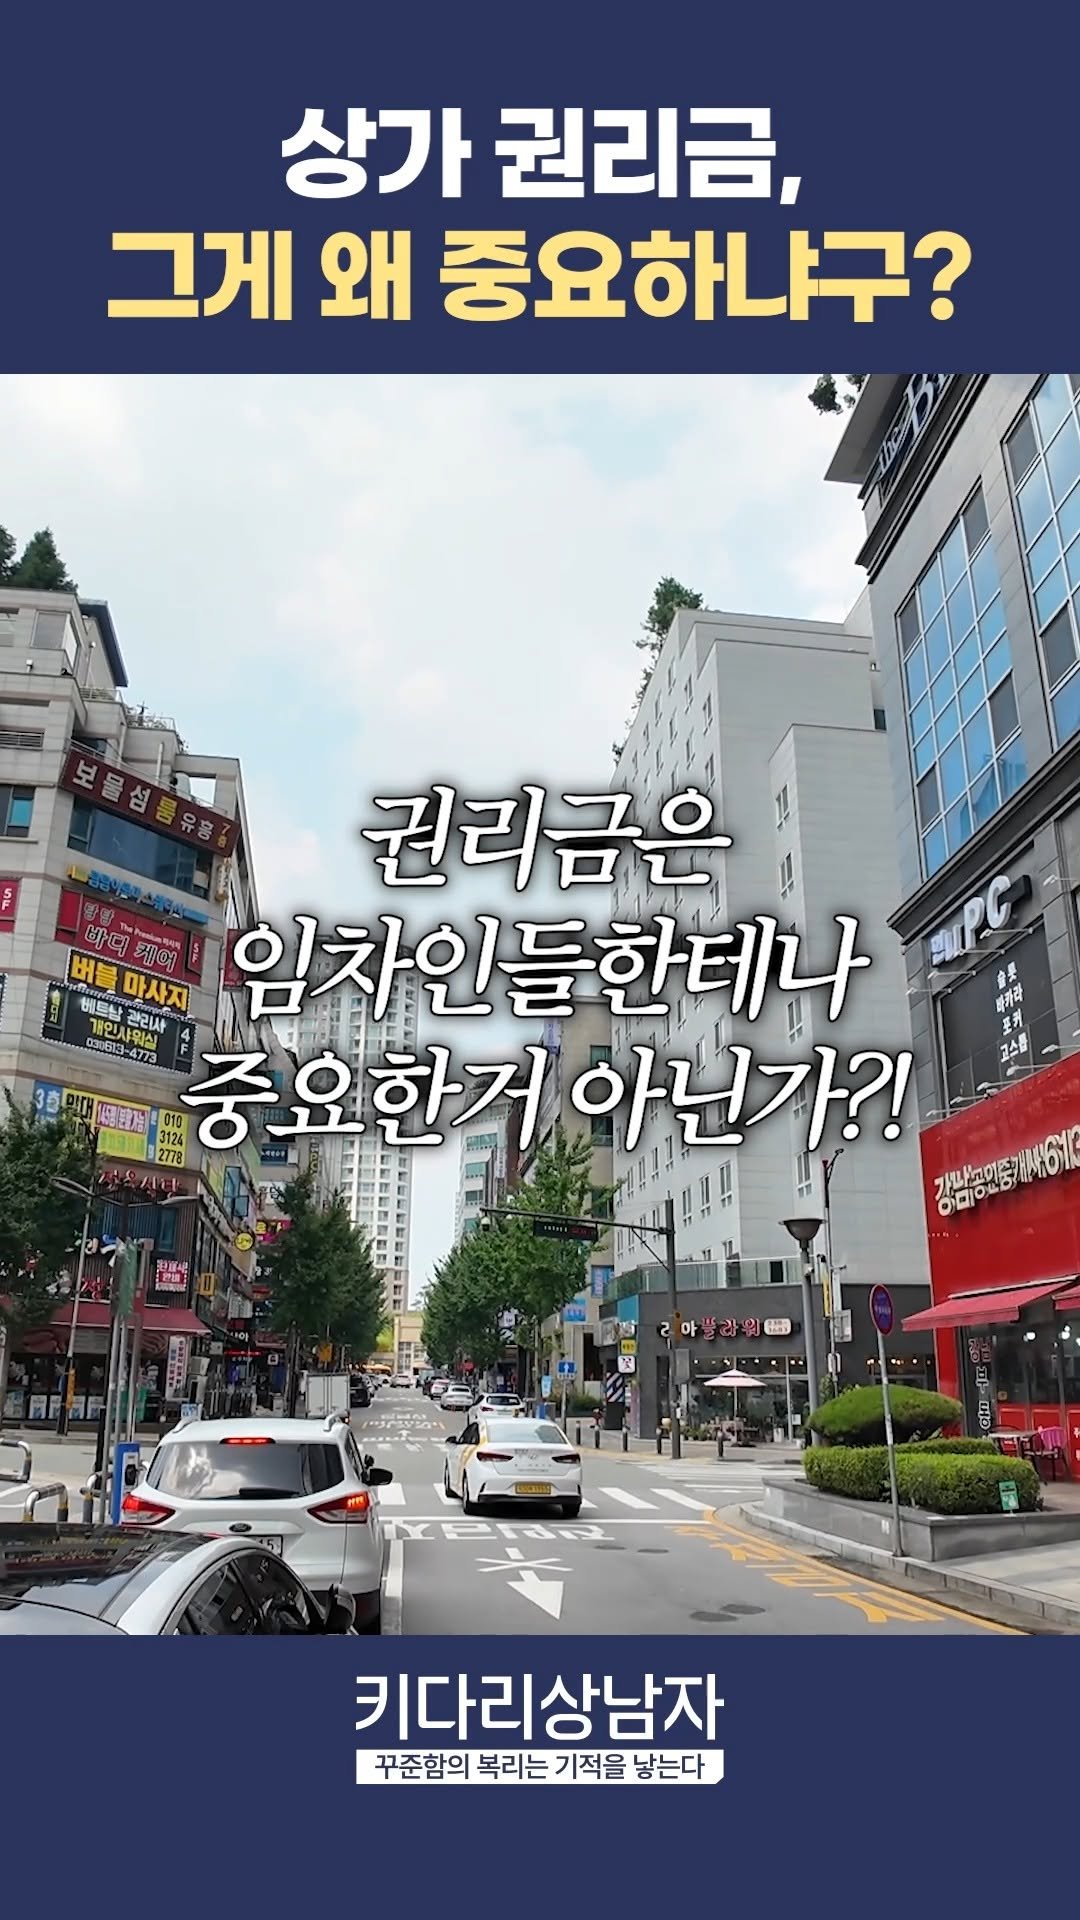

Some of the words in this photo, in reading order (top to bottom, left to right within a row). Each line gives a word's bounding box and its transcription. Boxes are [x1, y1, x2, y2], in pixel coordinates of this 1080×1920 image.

[180, 812, 215, 841] 유흥
[85, 925, 130, 957] 바디
[134, 941, 177, 972] 케어
[71, 956, 118, 993] 버블
[123, 970, 189, 1012] 마사지
[996, 982, 1023, 1013] 바카라
[80, 997, 124, 1022] 베트남
[127, 1009, 166, 1034] 관리사
[164, 1112, 183, 1128] 010
[159, 1130, 183, 1147] 3124
[158, 1148, 183, 1165] 2778
